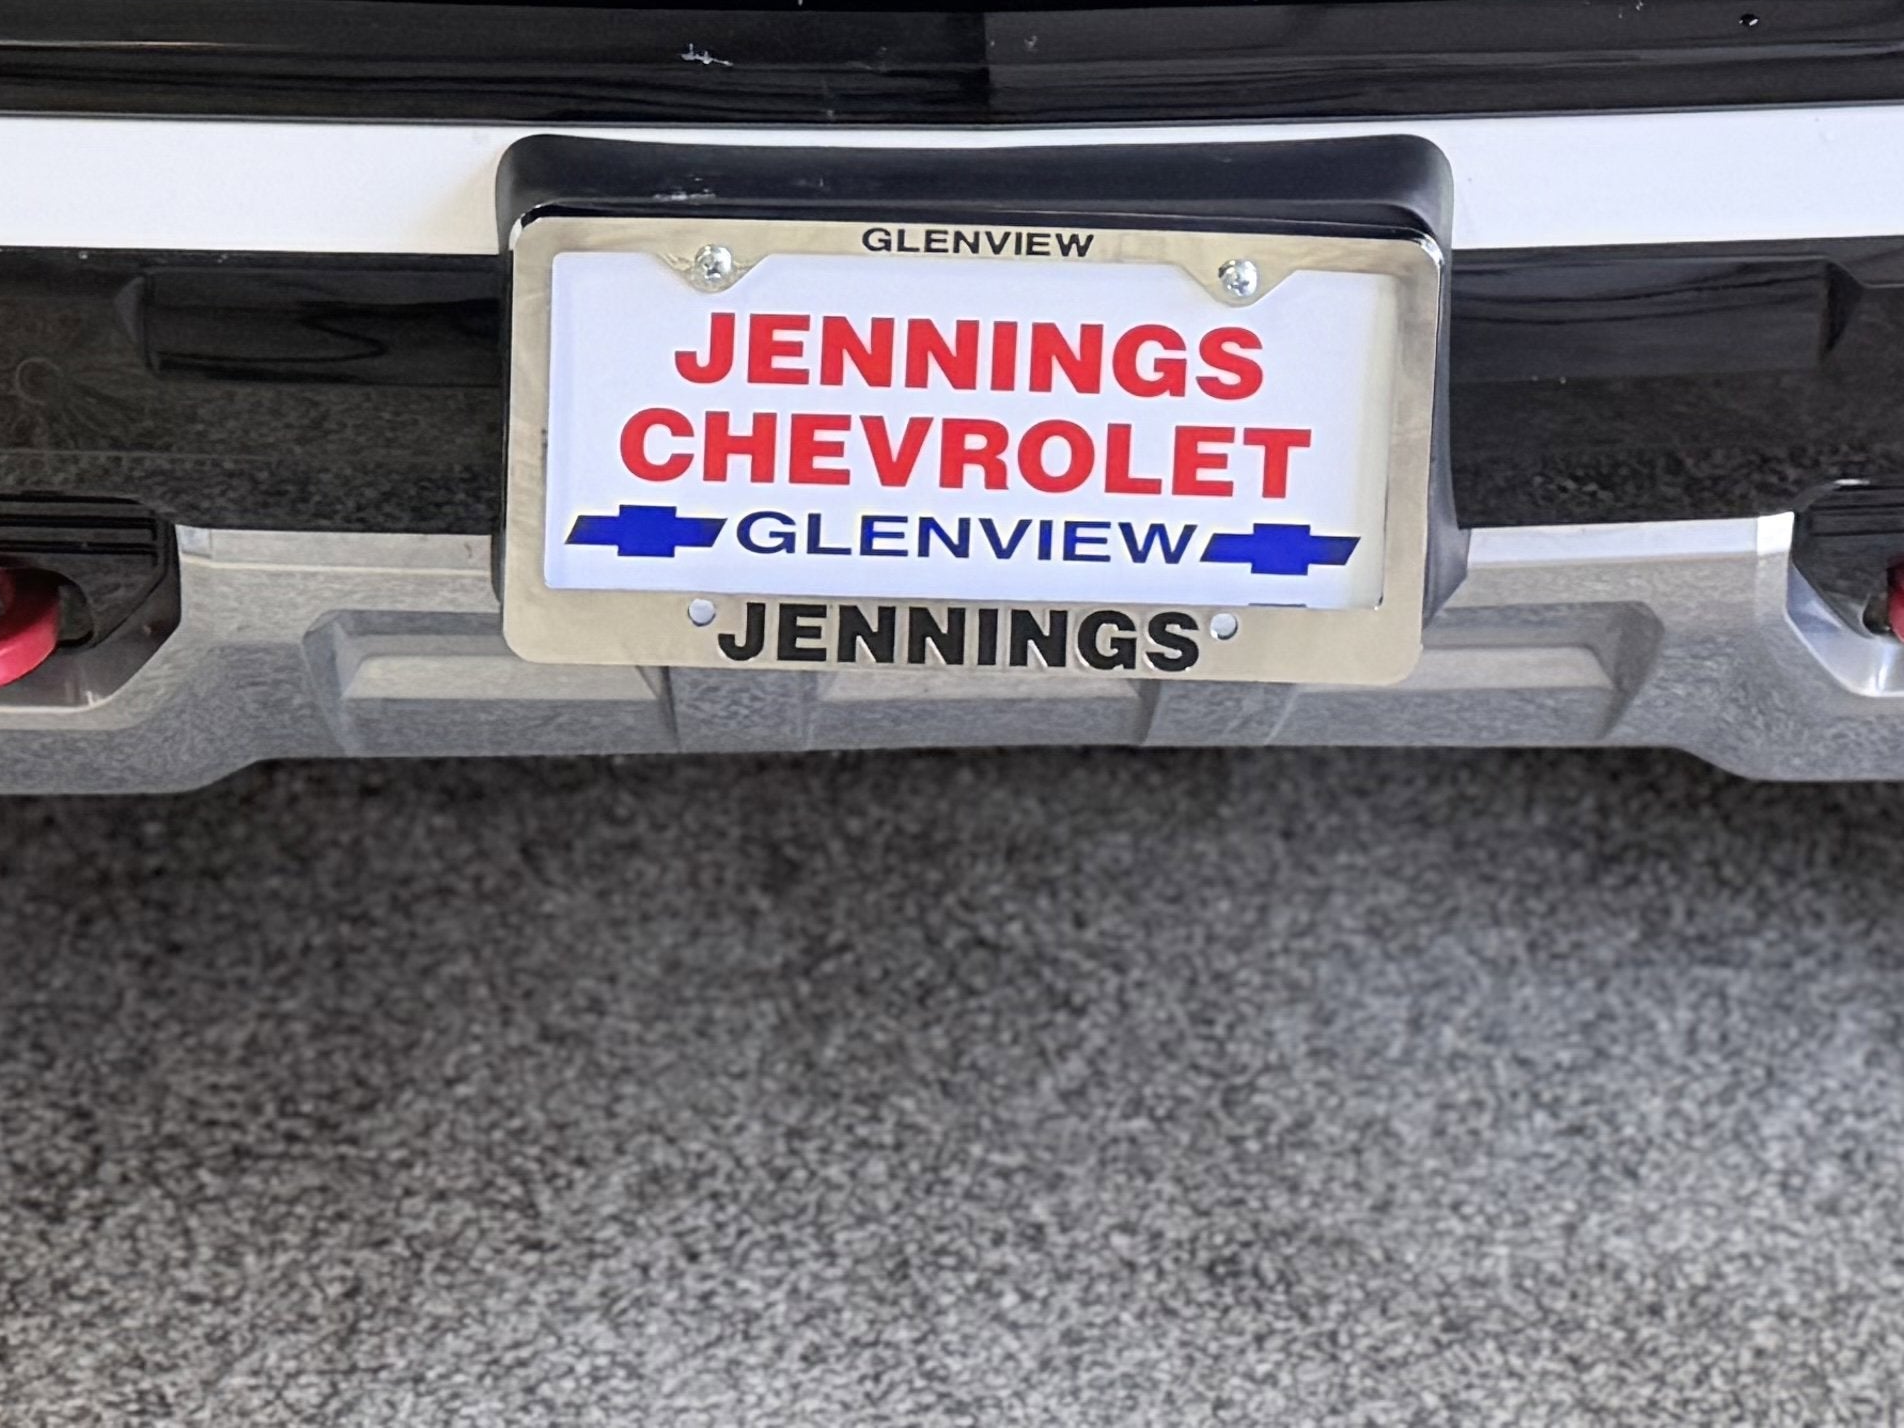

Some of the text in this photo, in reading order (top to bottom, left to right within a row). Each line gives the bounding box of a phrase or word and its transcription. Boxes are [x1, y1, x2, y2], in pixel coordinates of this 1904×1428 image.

[862, 227, 1095, 258] GLENVIEW
[675, 312, 1265, 402] JENNINGS
[619, 408, 1313, 500] CHEVROLET
[735, 511, 1199, 566] GLENVIEW
[716, 601, 1200, 673] JENNINGS
